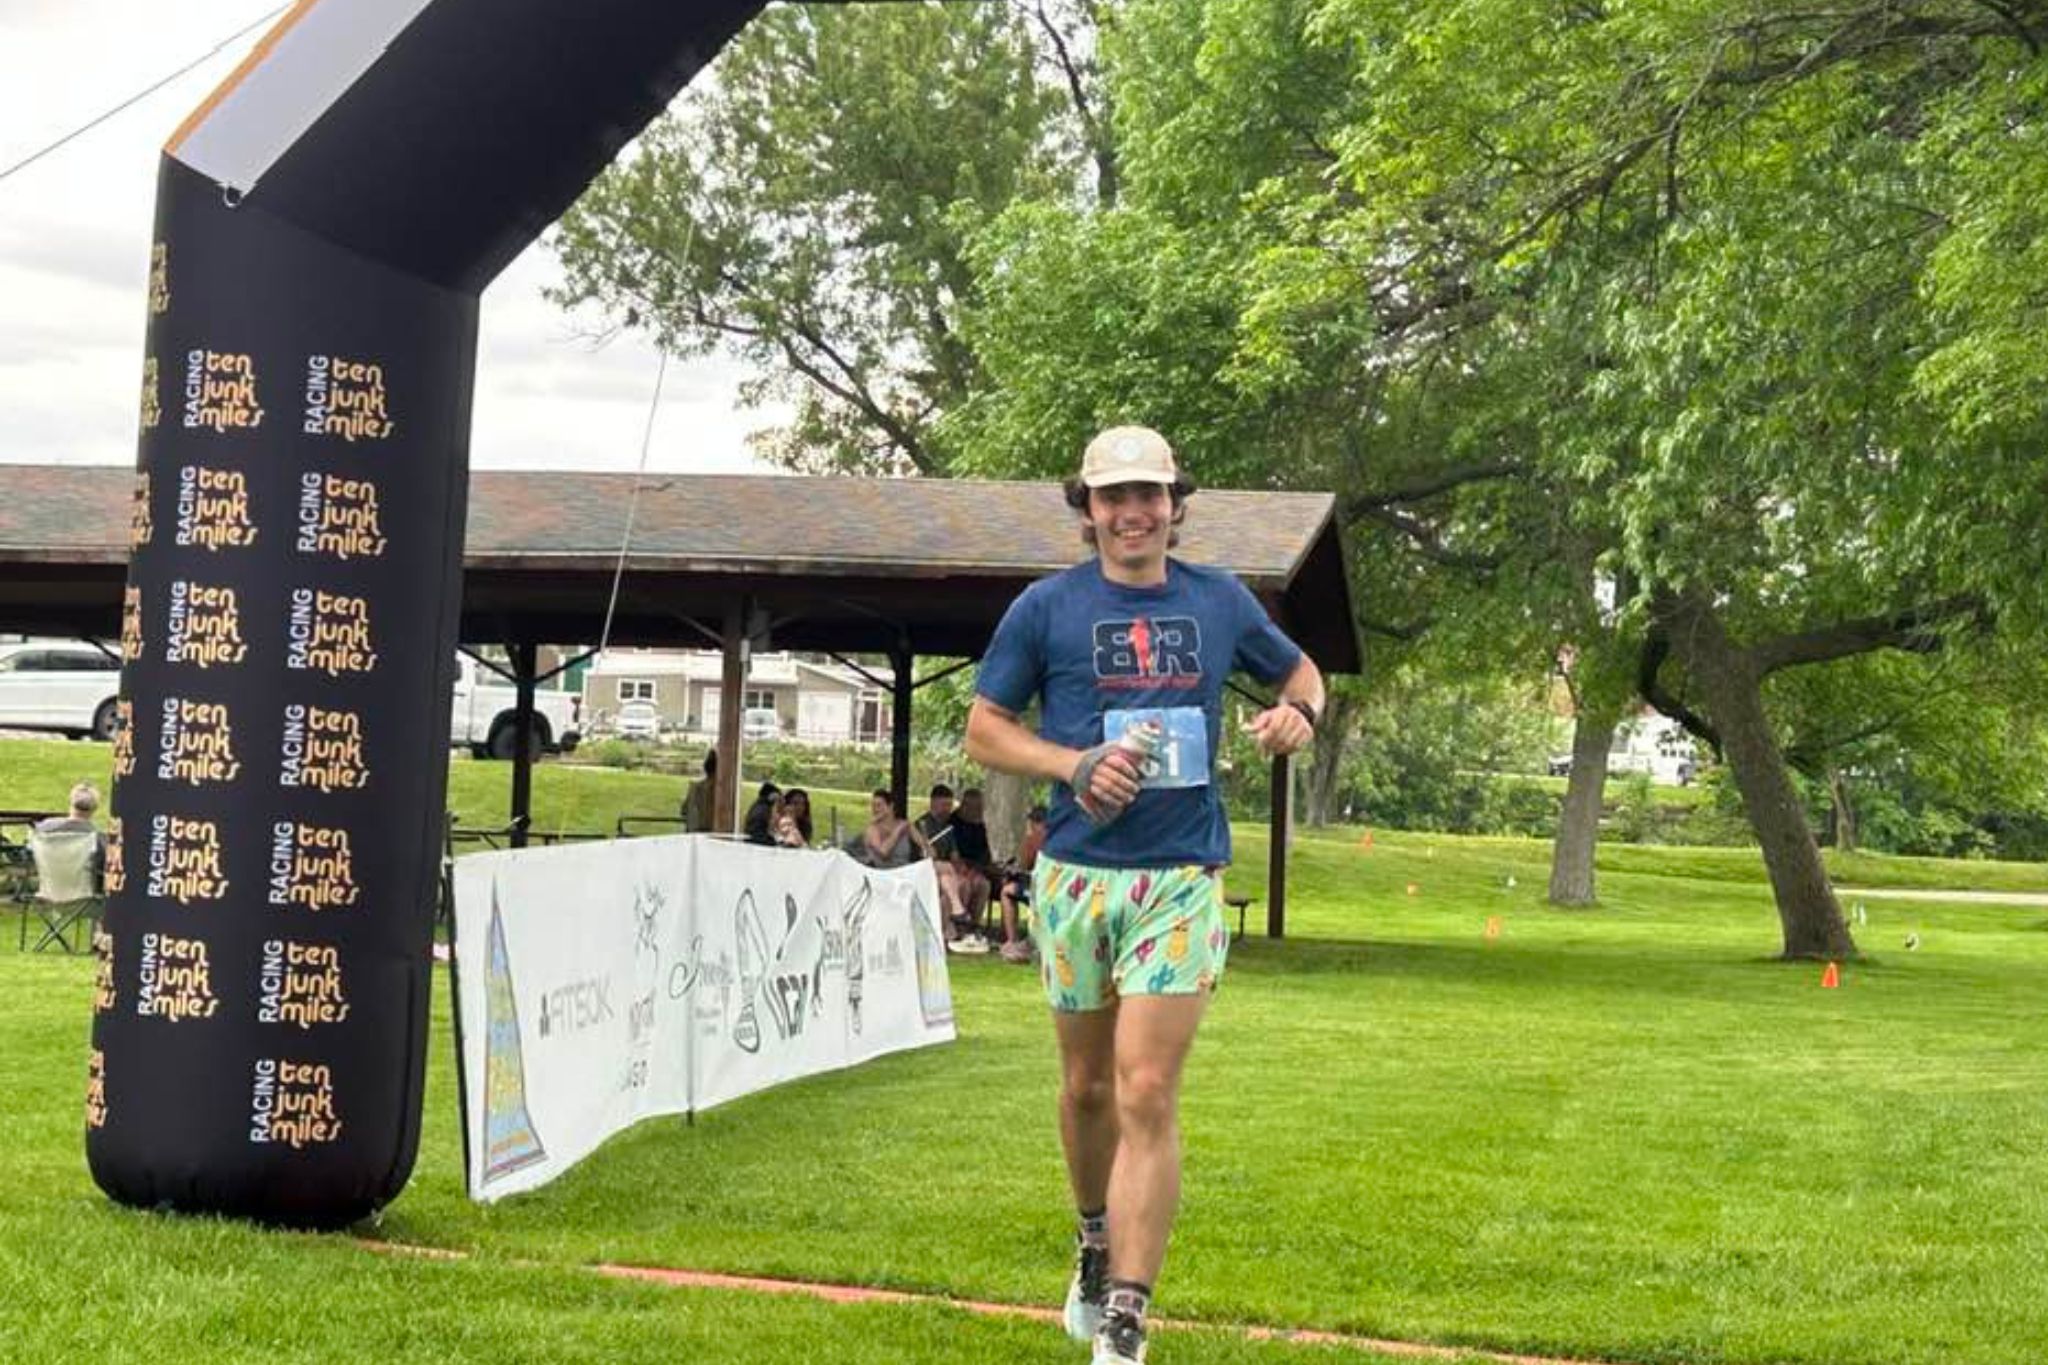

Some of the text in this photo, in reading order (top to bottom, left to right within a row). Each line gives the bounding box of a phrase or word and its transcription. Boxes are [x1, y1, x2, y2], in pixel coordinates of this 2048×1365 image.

[205, 350, 255, 378] ten
[333, 358, 383, 389] ten
[184, 350, 203, 427] RACING
[200, 375, 258, 407] junk
[304, 356, 328, 434] RACING
[326, 382, 387, 418] junk
[200, 402, 264, 433] miles
[326, 411, 393, 441] miles
[198, 466, 249, 495] ten
[326, 475, 376, 507] ten
[176, 466, 195, 545] RACING
[192, 492, 252, 524] junk
[297, 473, 321, 553] RACING
[319, 500, 380, 536] junk
[192, 519, 258, 551] miles
[319, 529, 386, 560] miles
[188, 581, 238, 610] ten
[317, 591, 367, 623] ten
[167, 581, 186, 662] RACING
[183, 607, 241, 641] junk
[288, 589, 312, 669] RACING
[310, 616, 371, 652] junk
[183, 636, 247, 668] miles
[310, 645, 377, 676] miles
[180, 698, 231, 728] ten
[309, 706, 359, 739] ten
[158, 698, 177, 780] RACING
[174, 725, 234, 758] junk
[280, 704, 304, 786] RACING
[302, 731, 363, 769] junk
[174, 753, 240, 786] miles
[302, 762, 369, 793] miles
[169, 815, 220, 845] ten
[298, 824, 349, 856] ten
[147, 815, 166, 898] RACING
[163, 842, 223, 876] junk
[269, 822, 293, 903] RACING
[291, 849, 353, 886] junk
[163, 871, 229, 904] miles
[291, 879, 359, 910] miles
[159, 934, 209, 964] ten
[288, 943, 339, 975] ten
[138, 934, 157, 1016] RACING
[154, 961, 212, 994] junk
[259, 941, 283, 1022] RACING
[281, 968, 343, 1005] junk
[154, 989, 218, 1022] miles
[281, 998, 349, 1029] miles
[280, 1061, 331, 1090] ten
[251, 1060, 275, 1141] RACING
[273, 1086, 335, 1120] junk
[273, 1114, 341, 1148] miles
